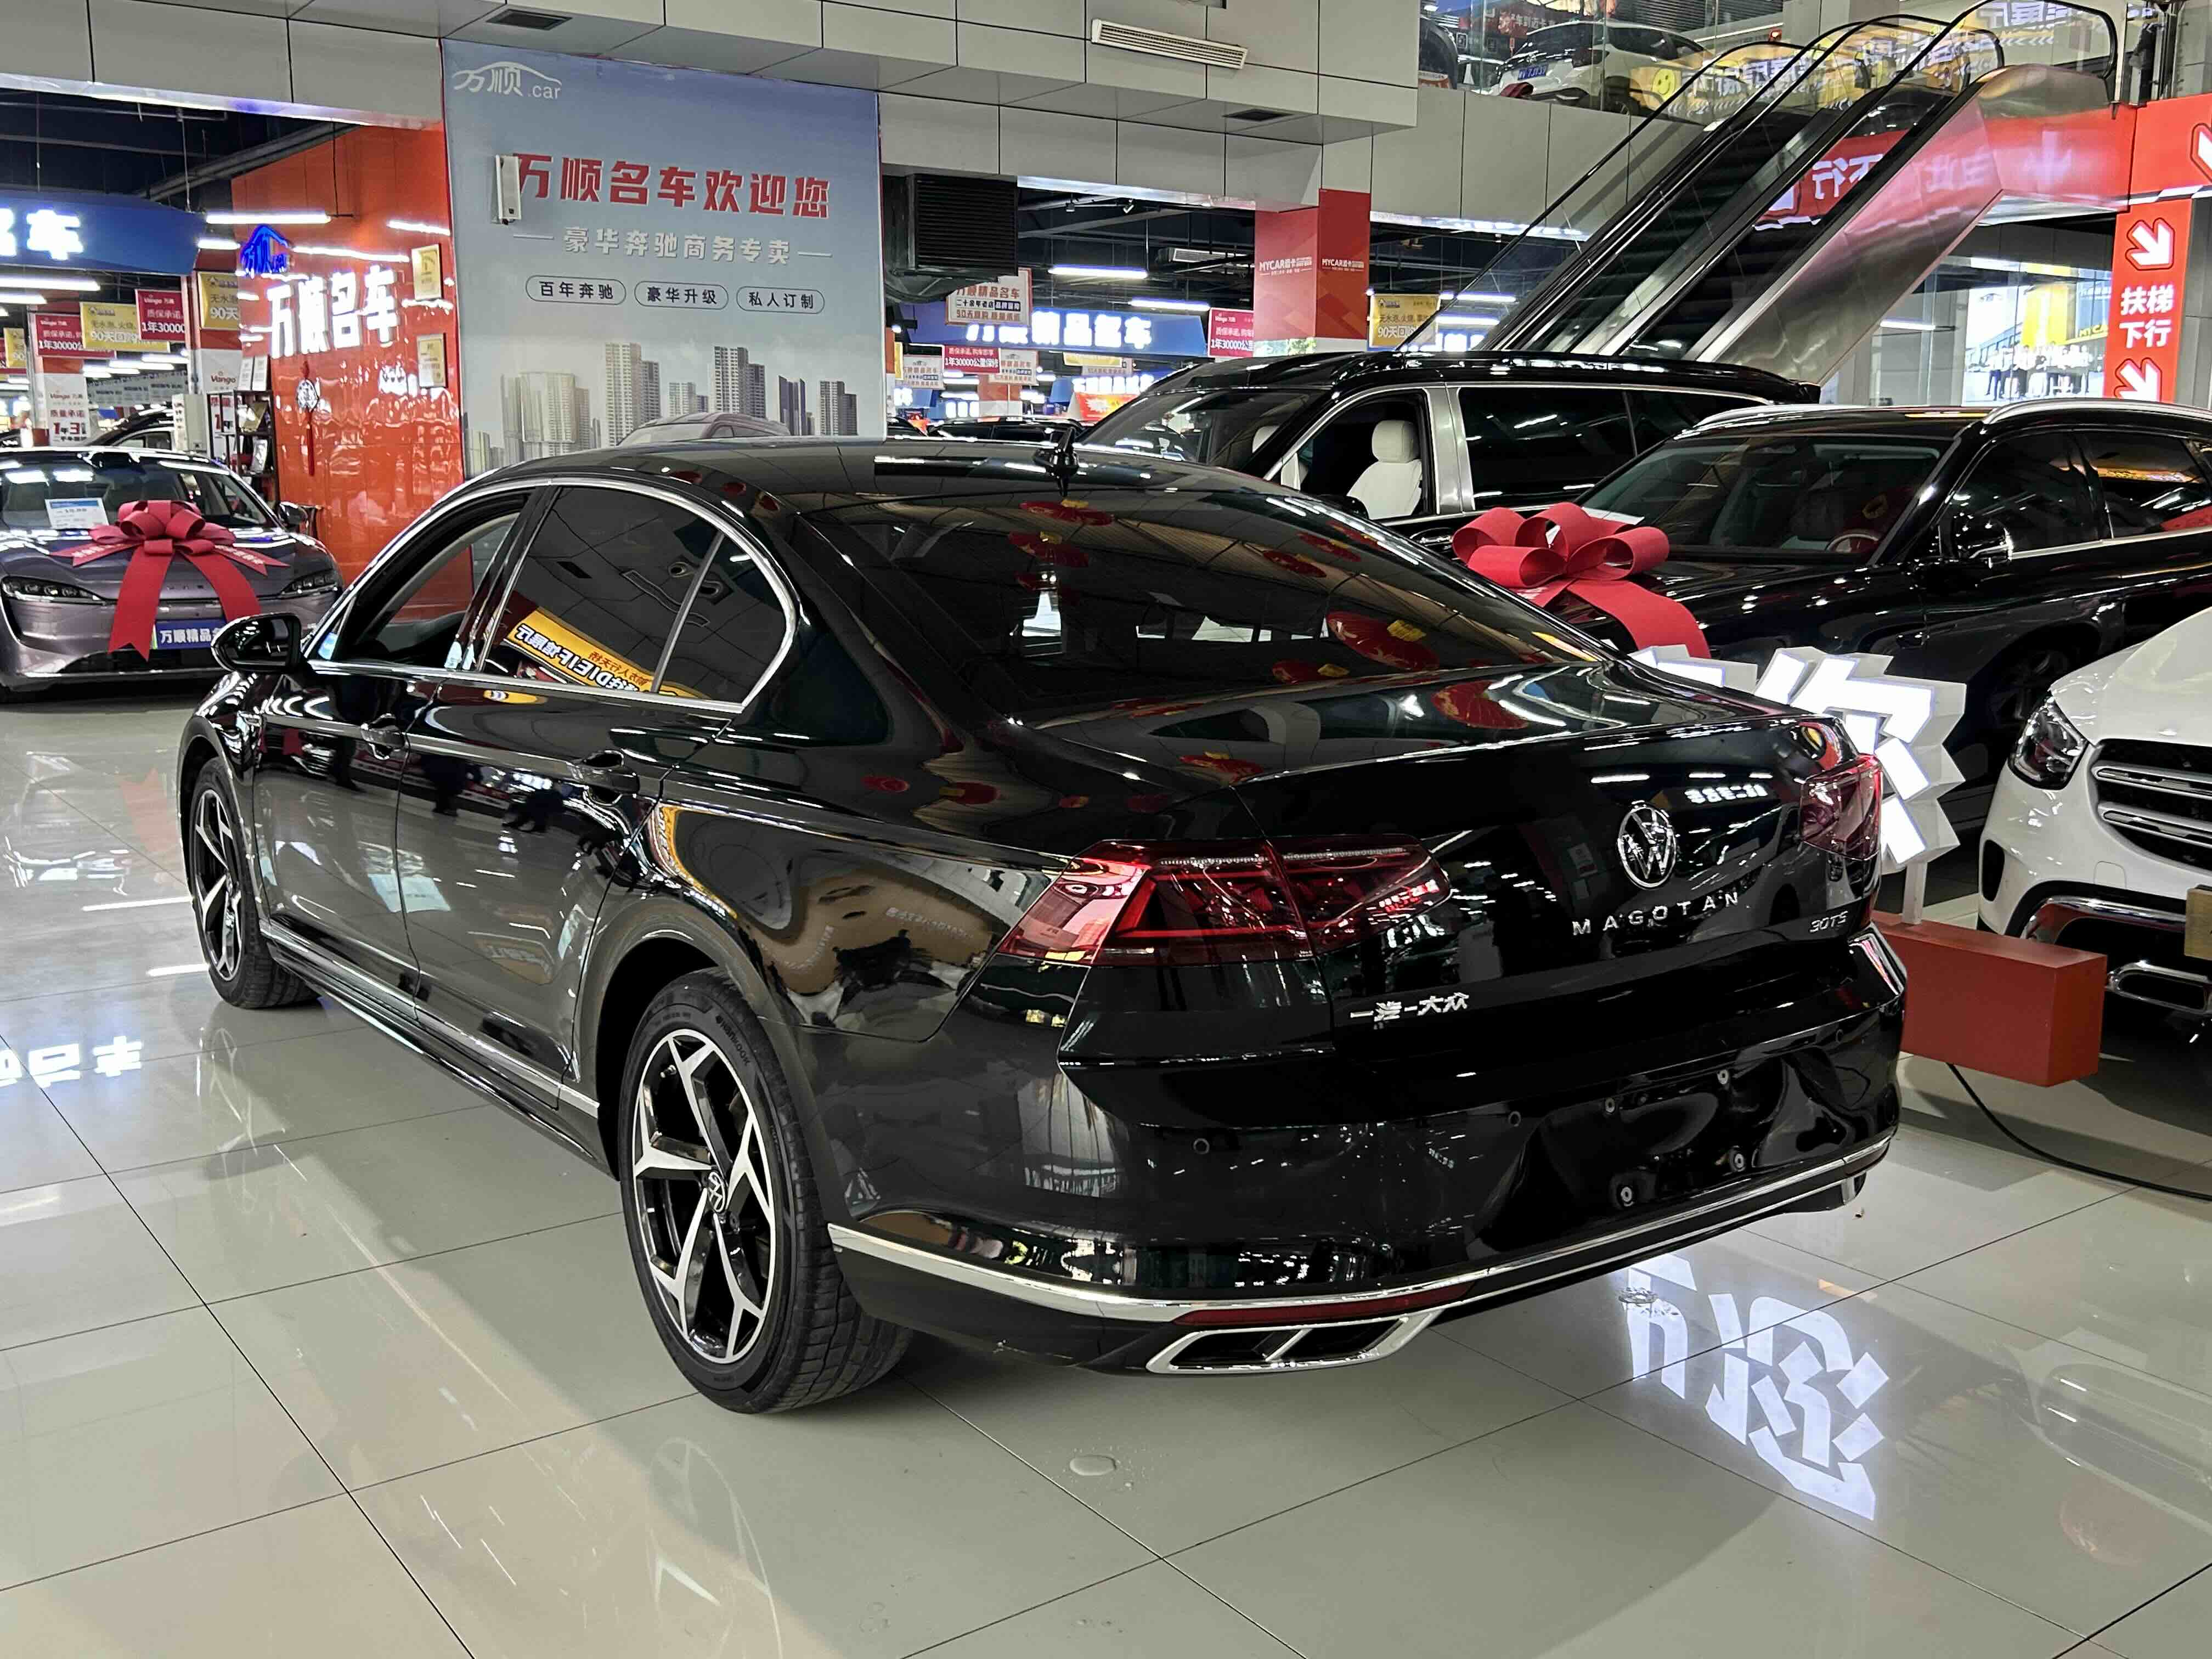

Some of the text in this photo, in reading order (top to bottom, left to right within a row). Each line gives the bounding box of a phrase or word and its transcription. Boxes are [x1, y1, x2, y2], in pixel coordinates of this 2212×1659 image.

[453, 61, 562, 100] 万顺 .car
[514, 153, 830, 219] 万顺名车欢迎您
[563, 225, 791, 265] 豪华奔驰商务专卖
[539, 280, 614, 301] 百年奔驰
[647, 286, 718, 306] 豪华升级
[748, 291, 814, 310] 私人订制
[2120, 284, 2174, 315] 扶梯
[267, 265, 399, 359] 万顺名车
[2119, 319, 2171, 348] 下行
[1571, 891, 1738, 936] MAGOTAN
